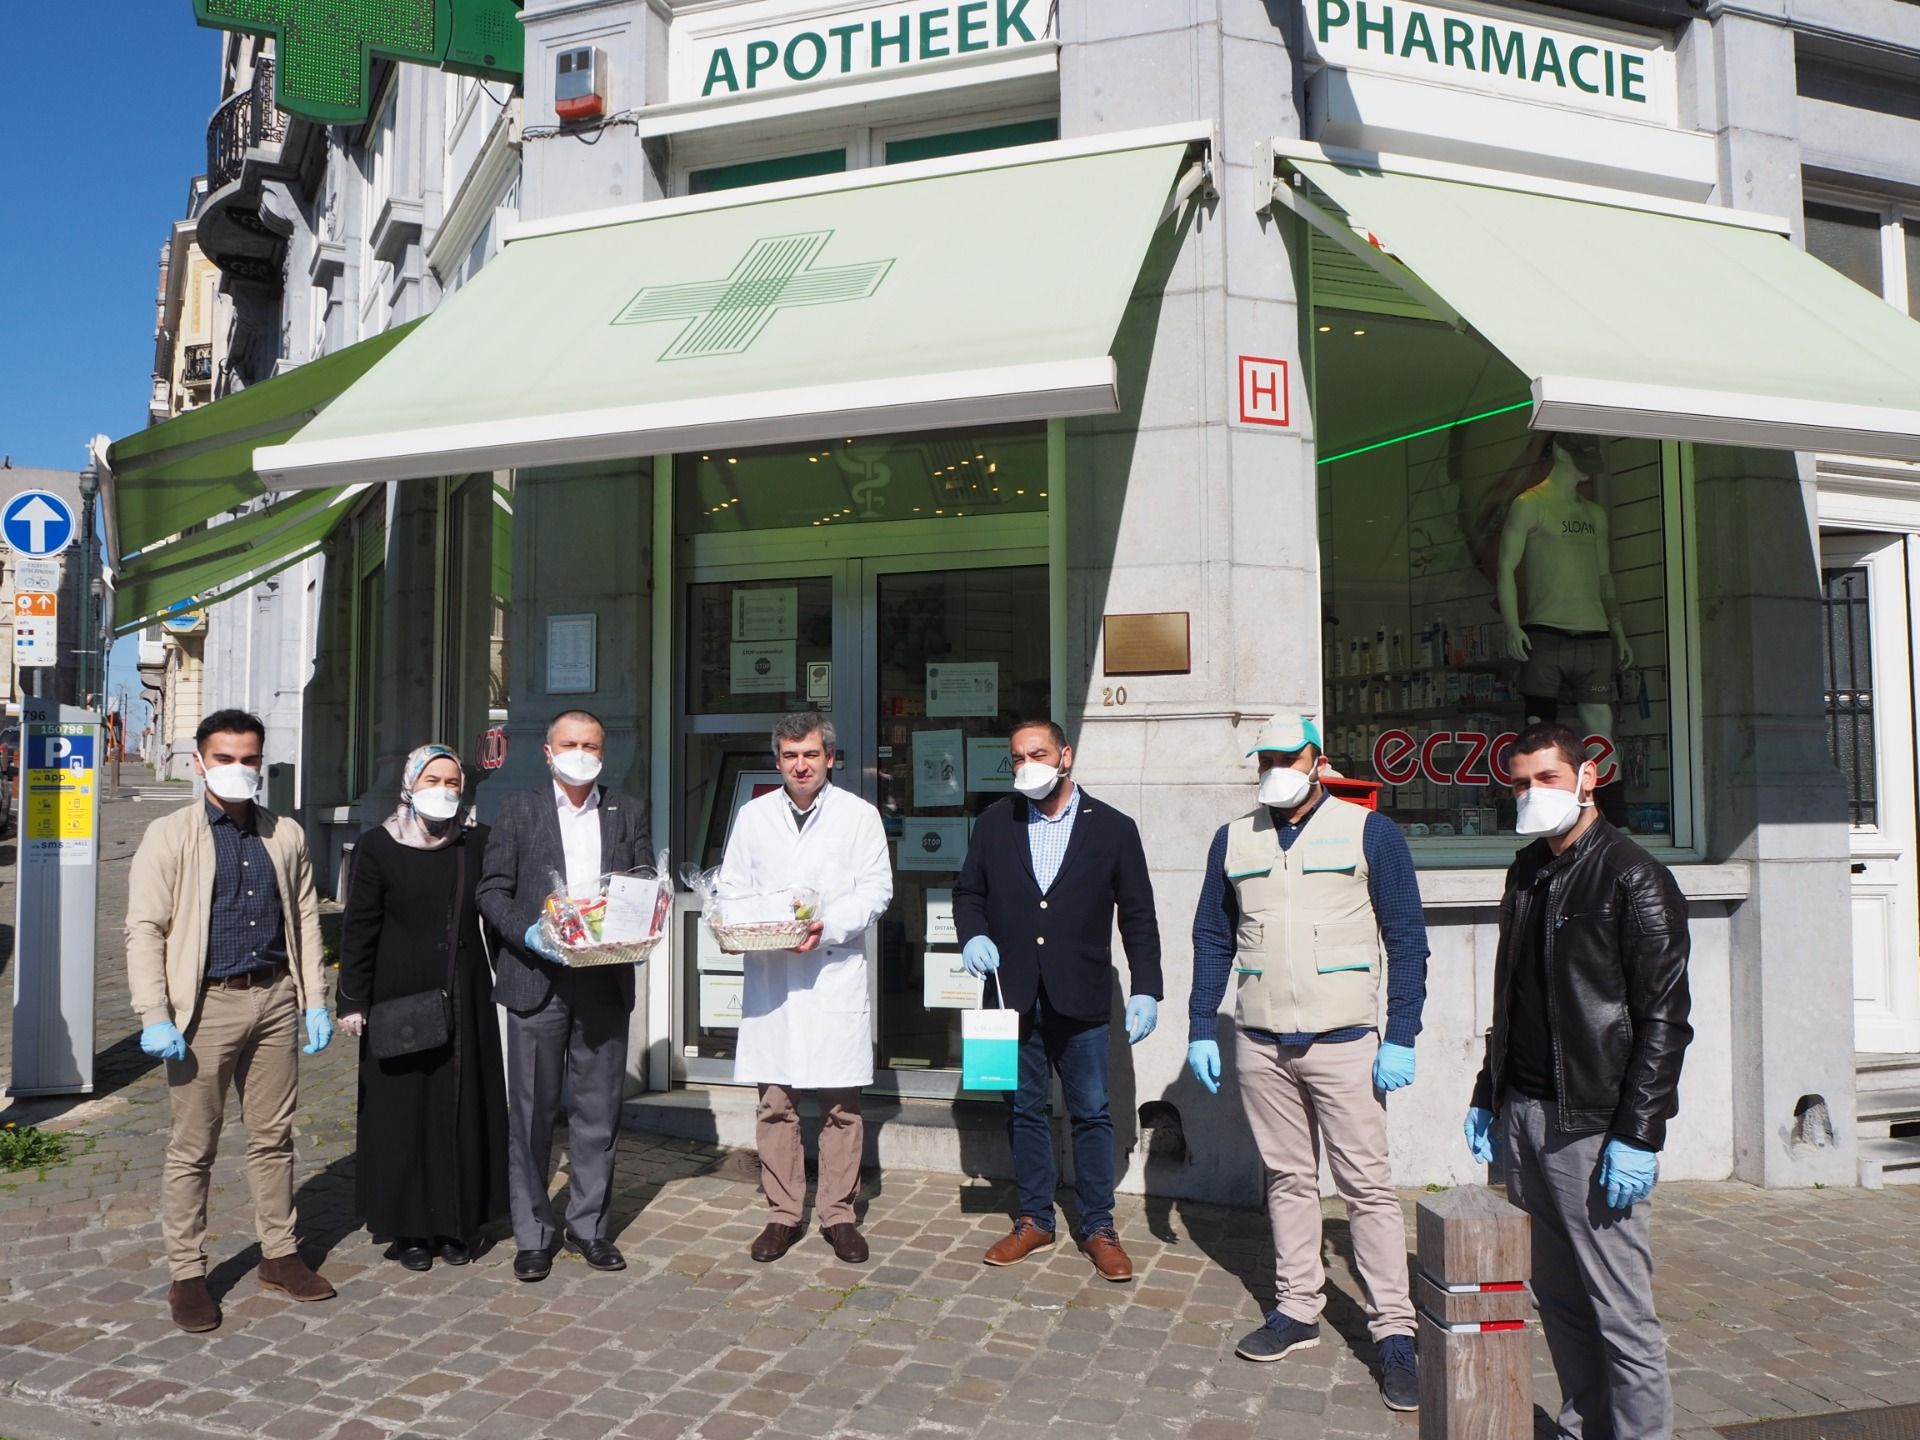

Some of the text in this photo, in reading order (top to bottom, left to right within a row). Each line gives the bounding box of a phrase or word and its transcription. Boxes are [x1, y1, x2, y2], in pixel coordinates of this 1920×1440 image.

[701, 0, 1037, 96] APOTHEEK
[1317, 0, 1647, 103] PHARMACIE
[1251, 369, 1277, 412] H
[1562, 520, 1595, 535] SLOAN
[1103, 687, 1127, 706] 20
[23, 711, 46, 720] 796
[41, 725, 84, 734] 150796
[1372, 728, 1618, 787] eczoe
[44, 774, 66, 782] app
[41, 841, 64, 849] sms
[923, 838, 941, 846] STOP
